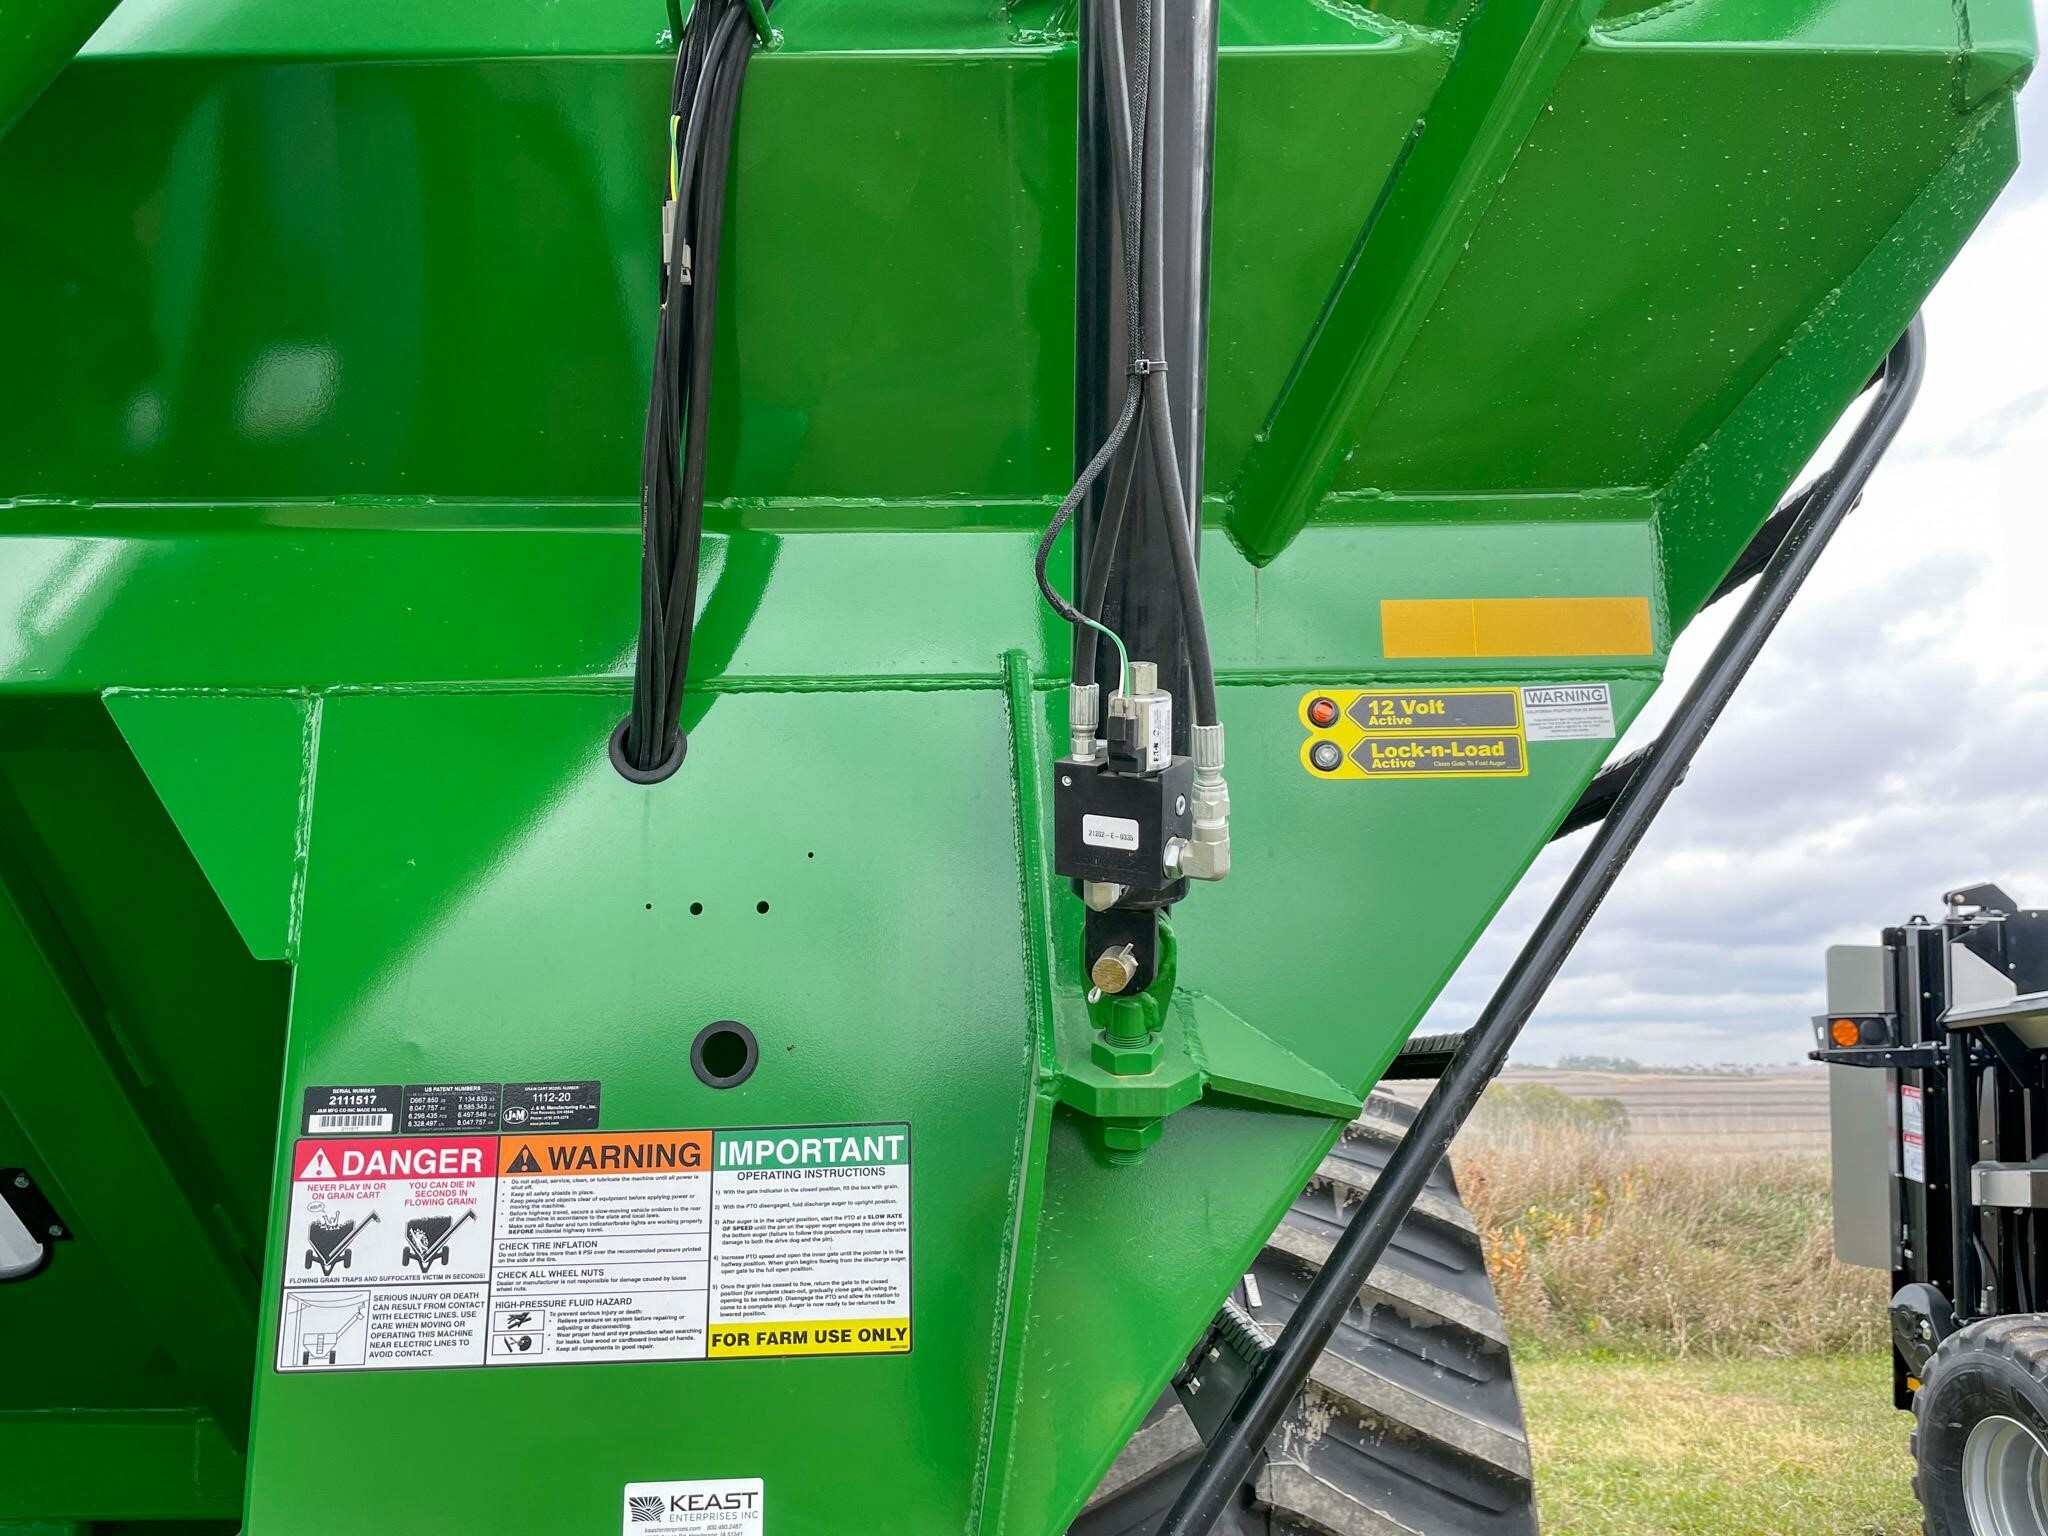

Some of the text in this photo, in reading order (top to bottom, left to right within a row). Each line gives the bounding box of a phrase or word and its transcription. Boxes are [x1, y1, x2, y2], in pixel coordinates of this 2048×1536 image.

[1528, 690, 1603, 703] WARNING
[1368, 699, 1445, 716] 12 Volt
[1368, 715, 1413, 726] Active
[1371, 741, 1504, 759] Lock-n-Load
[1372, 758, 1416, 768] Active
[328, 1095, 377, 1105] 2111517
[533, 1093, 571, 1102] 1112-20
[720, 1135, 904, 1166] IMPORTANT
[548, 1142, 700, 1171] WARNING
[342, 1148, 482, 1176] DANGER
[737, 1168, 886, 1181] OPERATING INSTRUCTIONS
[404, 1198, 477, 1206] FLOWING GRAIN!
[553, 1241, 598, 1249] INFLATION
[497, 1271, 527, 1279] CHECK
[548, 1270, 578, 1278] WHEEL
[581, 1269, 604, 1277] NUTS
[373, 1292, 479, 1302] SERIOUS INJURY OR DEATH
[372, 1301, 485, 1311] CAN RESULT FROM CONTACT
[495, 1298, 632, 1308] HIGH-PRESSURE FLUID HAZARD
[393, 1311, 431, 1319] ELECTRIC
[434, 1311, 457, 1319] LINES.
[460, 1310, 477, 1318] USE
[395, 1321, 418, 1329] WHEN
[420, 1320, 451, 1329] MOVING
[453, 1320, 466, 1328] OR
[370, 1329, 473, 1339] OPERATING THIS MACHINE
[711, 1328, 907, 1347] FOR FARM USE ONLY
[394, 1340, 431, 1348] ELECTRIC
[434, 1339, 456, 1348] LINES
[459, 1338, 470, 1347] TO
[394, 1349, 434, 1358] CONTACT.
[671, 1492, 758, 1511] KEAST
[669, 1511, 758, 1522] ENTERPRISES INC
